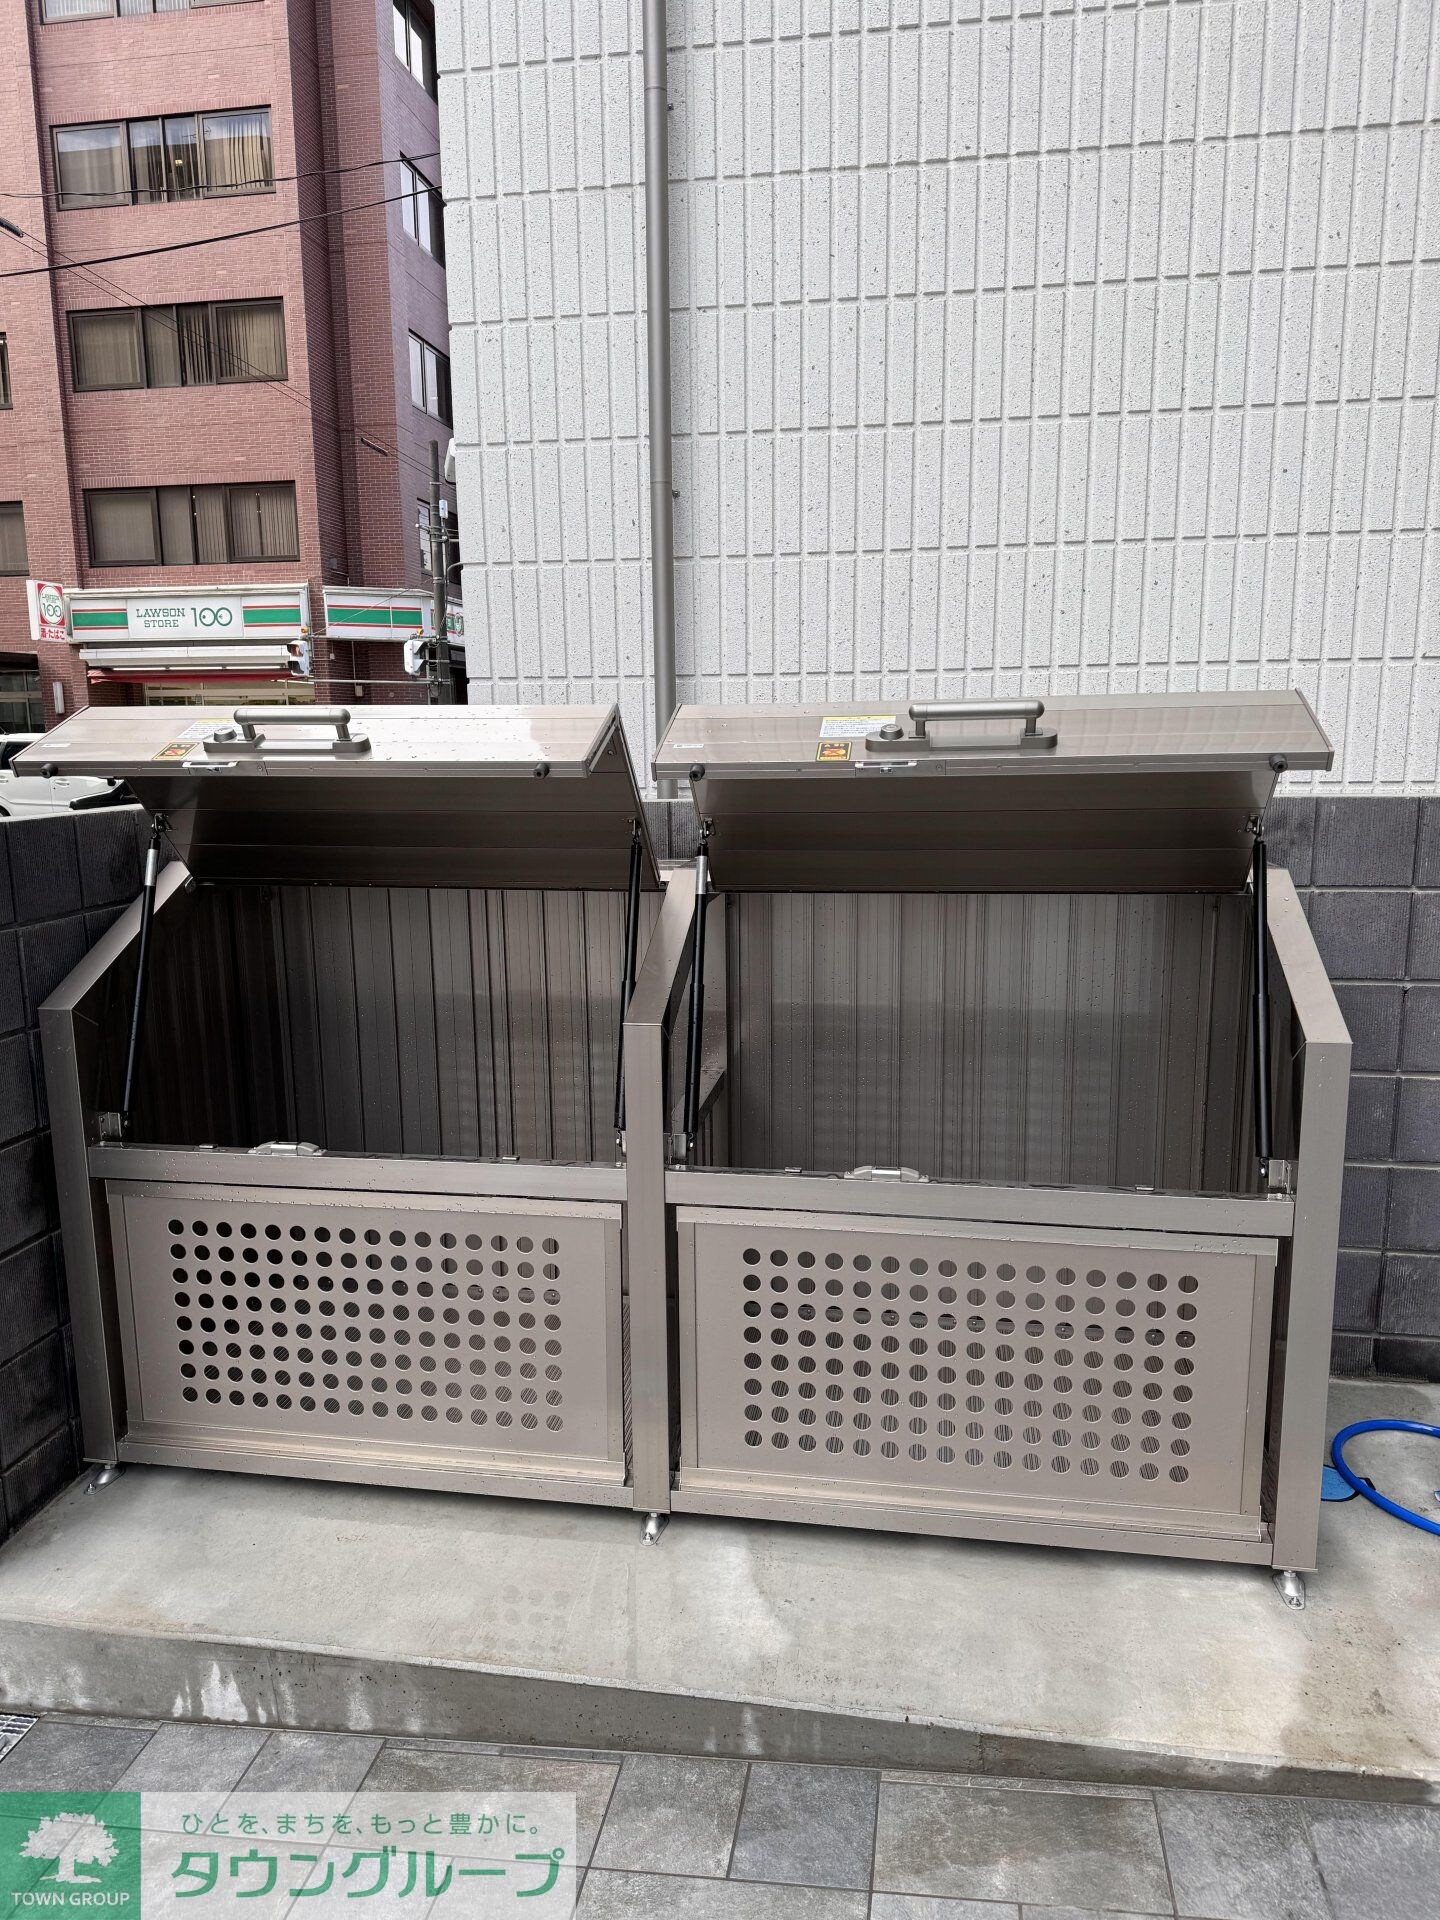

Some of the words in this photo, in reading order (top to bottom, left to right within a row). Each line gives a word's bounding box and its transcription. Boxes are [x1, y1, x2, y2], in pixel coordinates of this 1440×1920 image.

[42, 603, 62, 618] 100
[136, 608, 186, 618] LAWSON
[190, 606, 233, 627] 100
[144, 619, 179, 628] STORE
